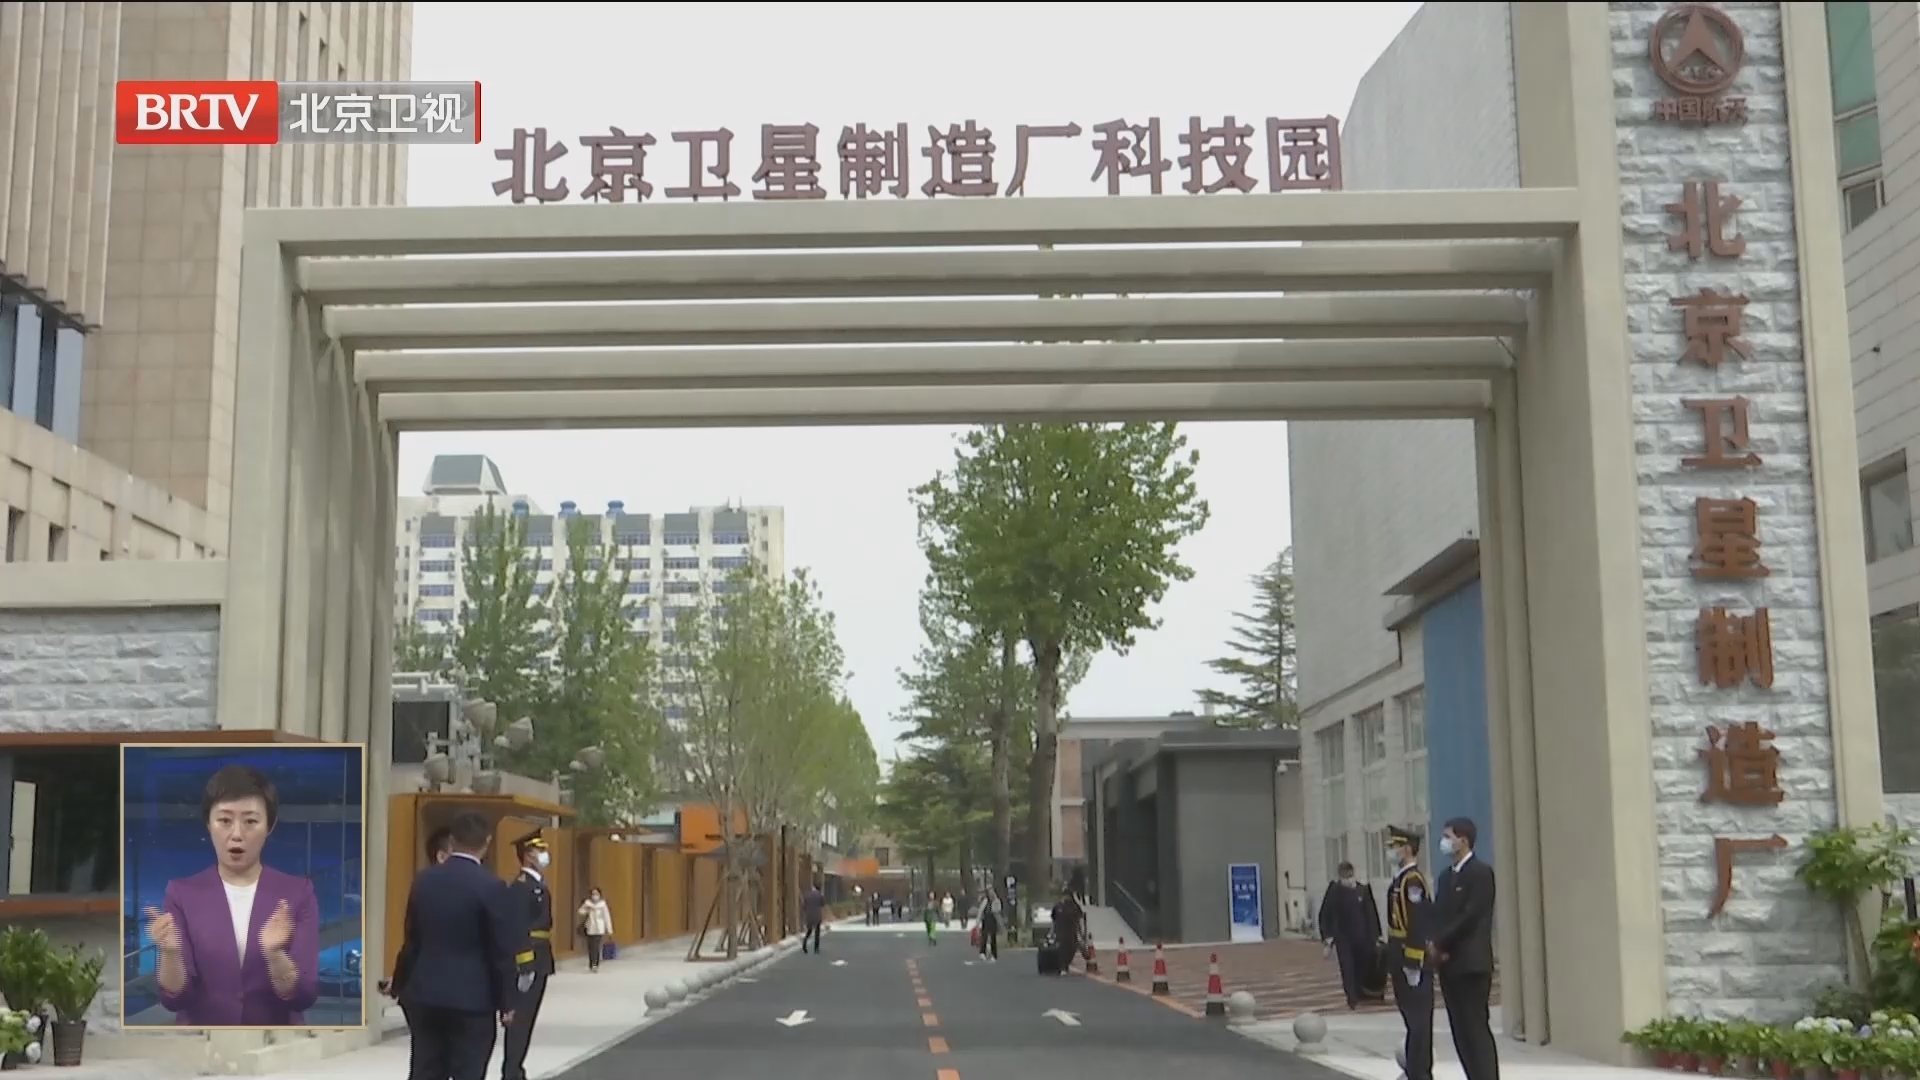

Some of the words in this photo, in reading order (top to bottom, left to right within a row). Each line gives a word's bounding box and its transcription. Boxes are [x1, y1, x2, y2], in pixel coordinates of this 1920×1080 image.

[492, 115, 1344, 203] 北京卫星制造厂科技园
[1664, 180, 1788, 918] 北京卫星制造厂
